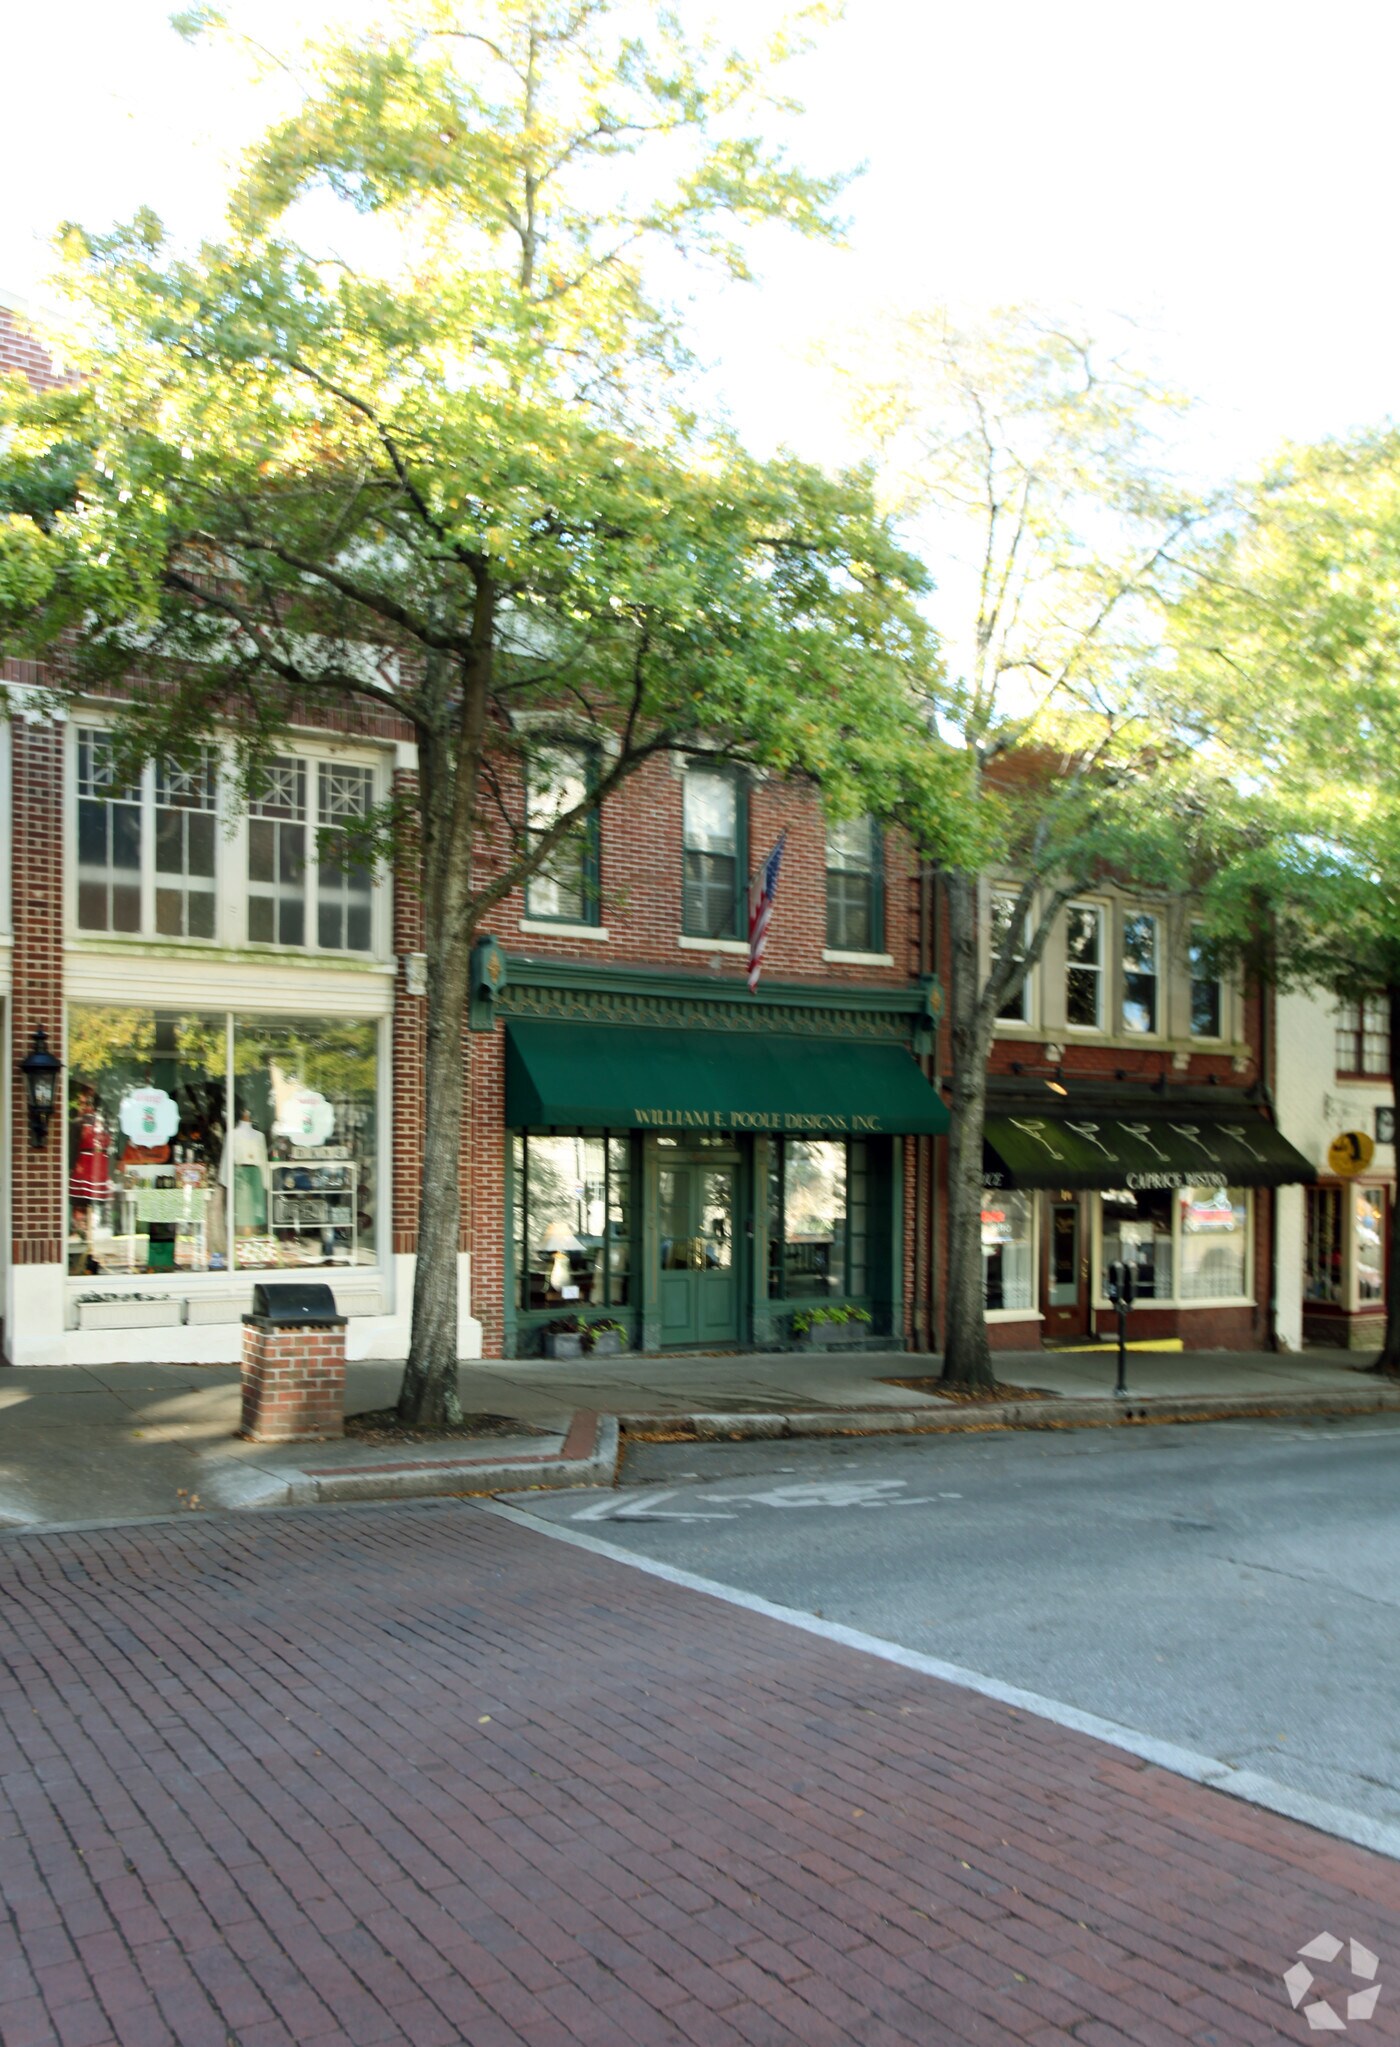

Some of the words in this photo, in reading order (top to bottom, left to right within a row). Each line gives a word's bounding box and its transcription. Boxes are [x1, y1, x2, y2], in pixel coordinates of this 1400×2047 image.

[634, 1109, 709, 1126] WILLIAM
[730, 1111, 781, 1128] POOLE
[1126, 1172, 1182, 1190] CAPRICE
[1184, 1172, 1228, 1188] BISTRO
